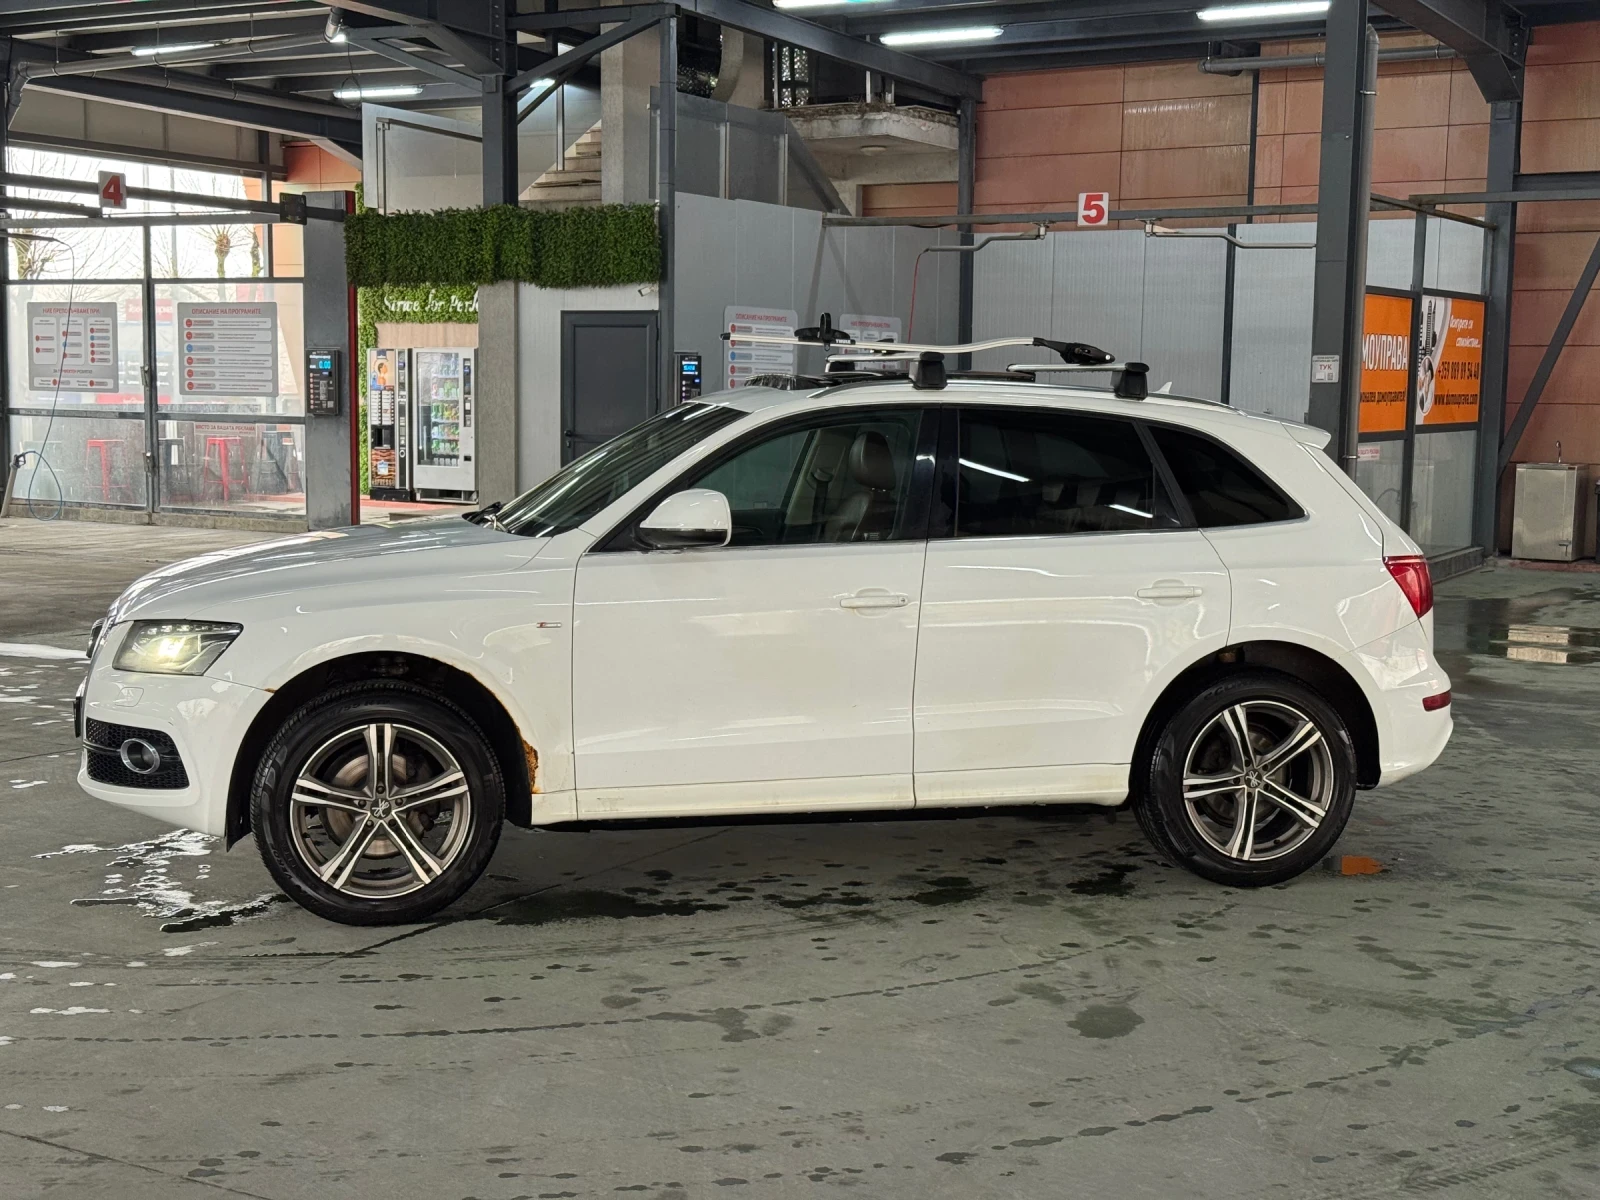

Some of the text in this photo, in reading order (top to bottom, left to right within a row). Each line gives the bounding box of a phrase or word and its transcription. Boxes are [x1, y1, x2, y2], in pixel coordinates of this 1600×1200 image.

[102, 175, 124, 207] 4
[1081, 193, 1105, 225] 5
[425, 288, 444, 312] for
[1437, 361, 1451, 380] +359
[1467, 361, 1473, 380] 54
